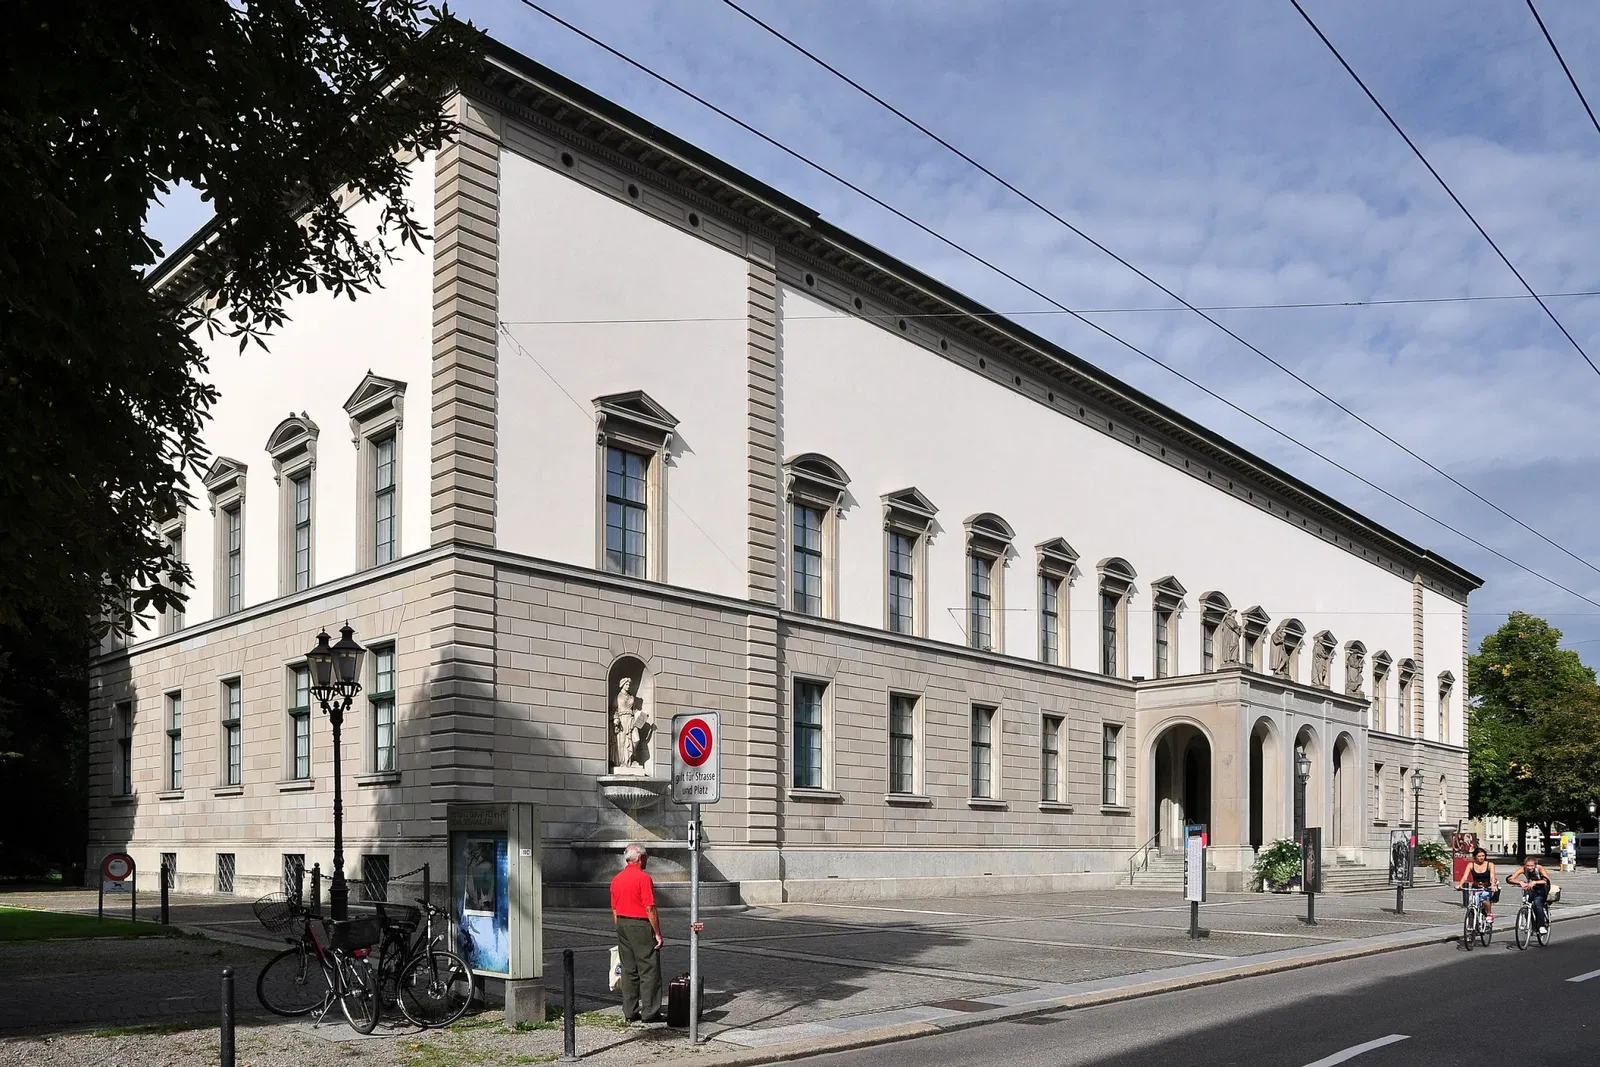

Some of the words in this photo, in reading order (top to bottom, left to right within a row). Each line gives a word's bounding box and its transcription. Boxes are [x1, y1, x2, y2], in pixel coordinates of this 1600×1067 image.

[675, 772, 685, 784] gilt
[686, 771, 694, 781] für
[695, 771, 715, 781] Strasse
[682, 785, 692, 795] und
[694, 785, 708, 795] Platz
